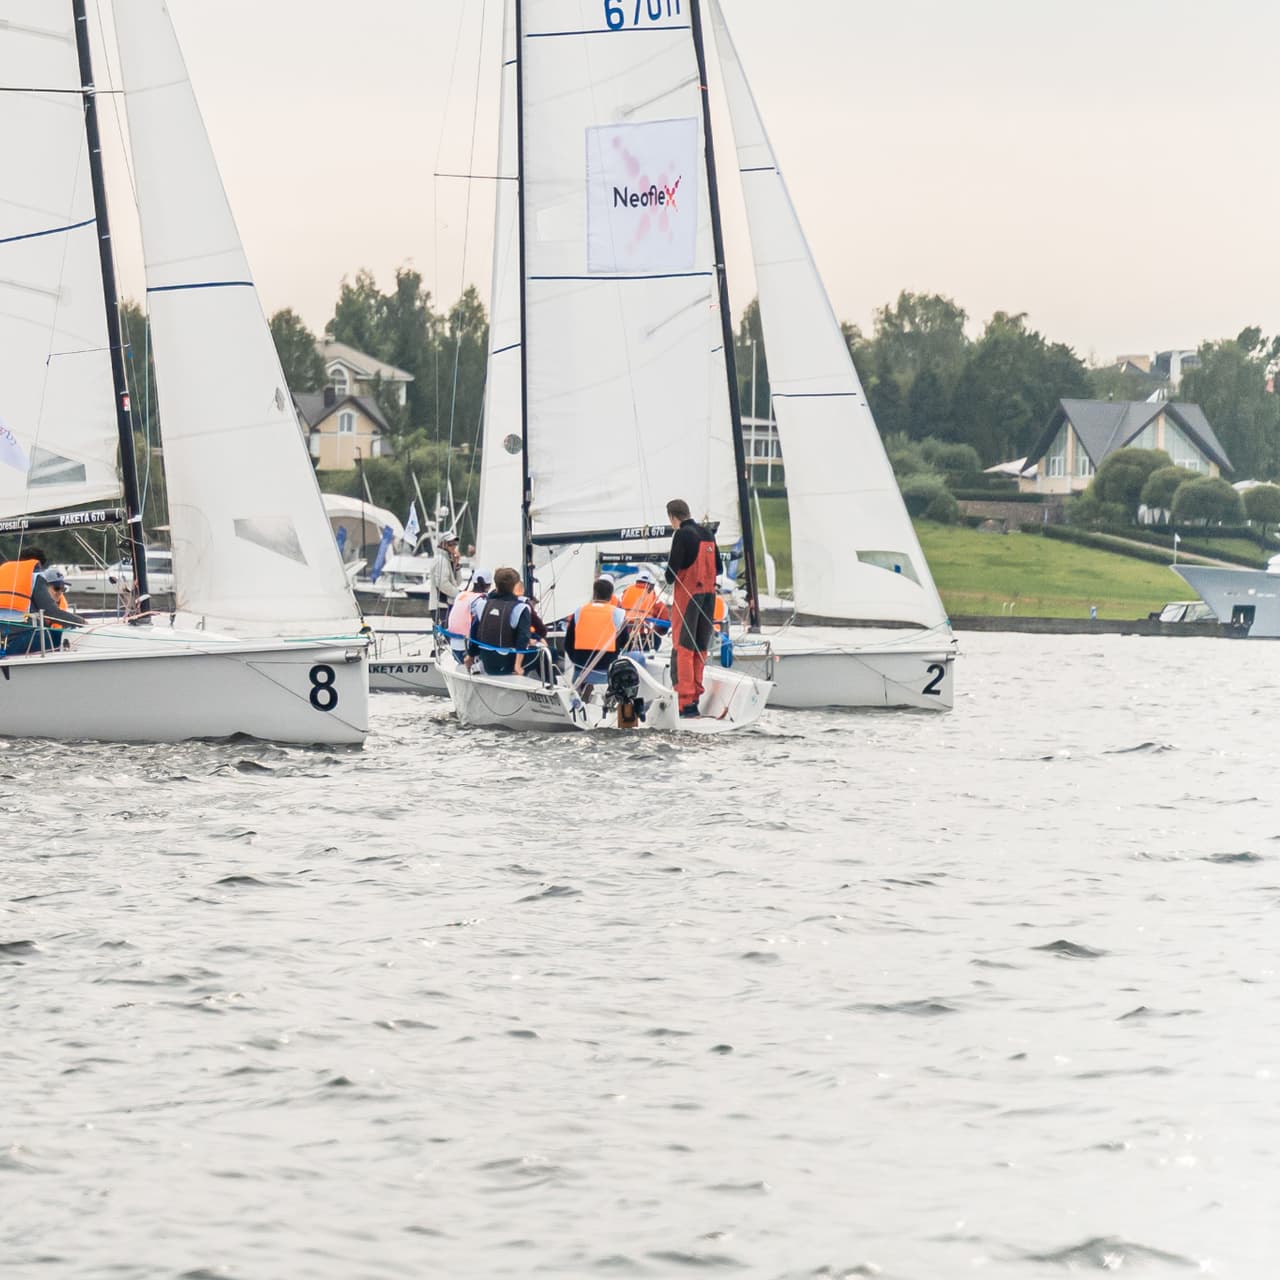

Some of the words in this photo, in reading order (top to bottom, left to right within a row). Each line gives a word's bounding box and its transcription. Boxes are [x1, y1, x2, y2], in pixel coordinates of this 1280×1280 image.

[91, 511, 106, 522] 670
[651, 526, 665, 537] 670
[407, 664, 429, 674] 670
[922, 663, 945, 696] 2
[309, 664, 338, 712] 8
[569, 705, 587, 723] 11
